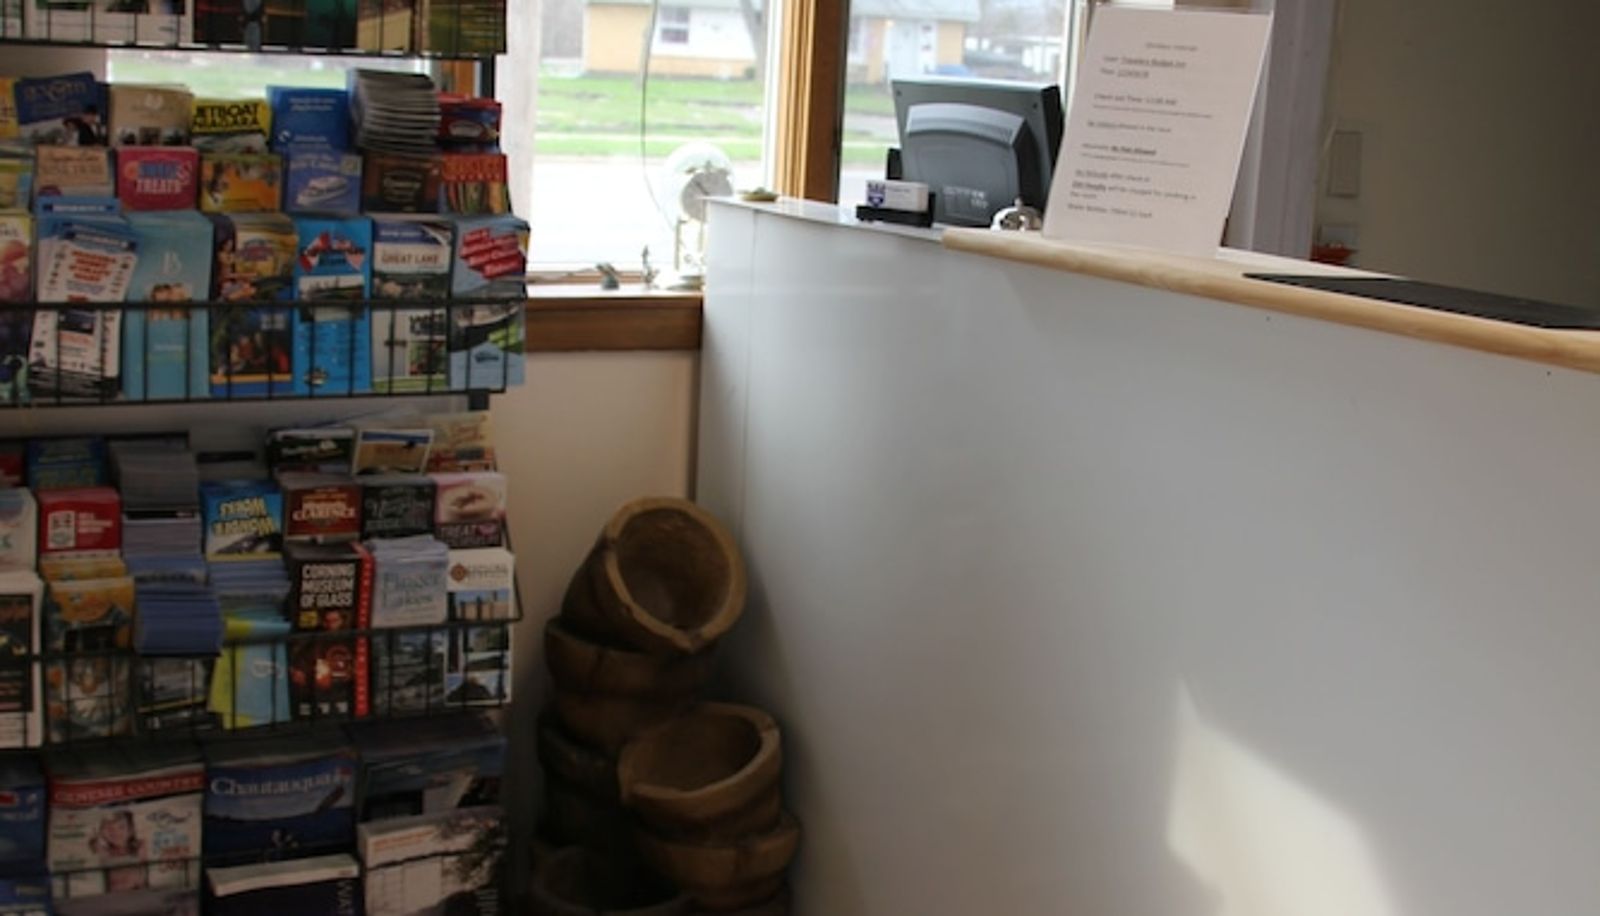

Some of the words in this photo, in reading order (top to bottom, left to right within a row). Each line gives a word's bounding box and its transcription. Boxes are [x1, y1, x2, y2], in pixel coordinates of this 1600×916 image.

[135, 178, 182, 194] TREATS
[382, 253, 411, 264] GREAT
[292, 507, 357, 522] CLARENCE
[302, 563, 356, 579] CORNING
[301, 578, 354, 593] MUSEUM
[300, 594, 315, 608] OF
[316, 592, 353, 608] GLASS
[127, 777, 202, 795] COUNTRY
